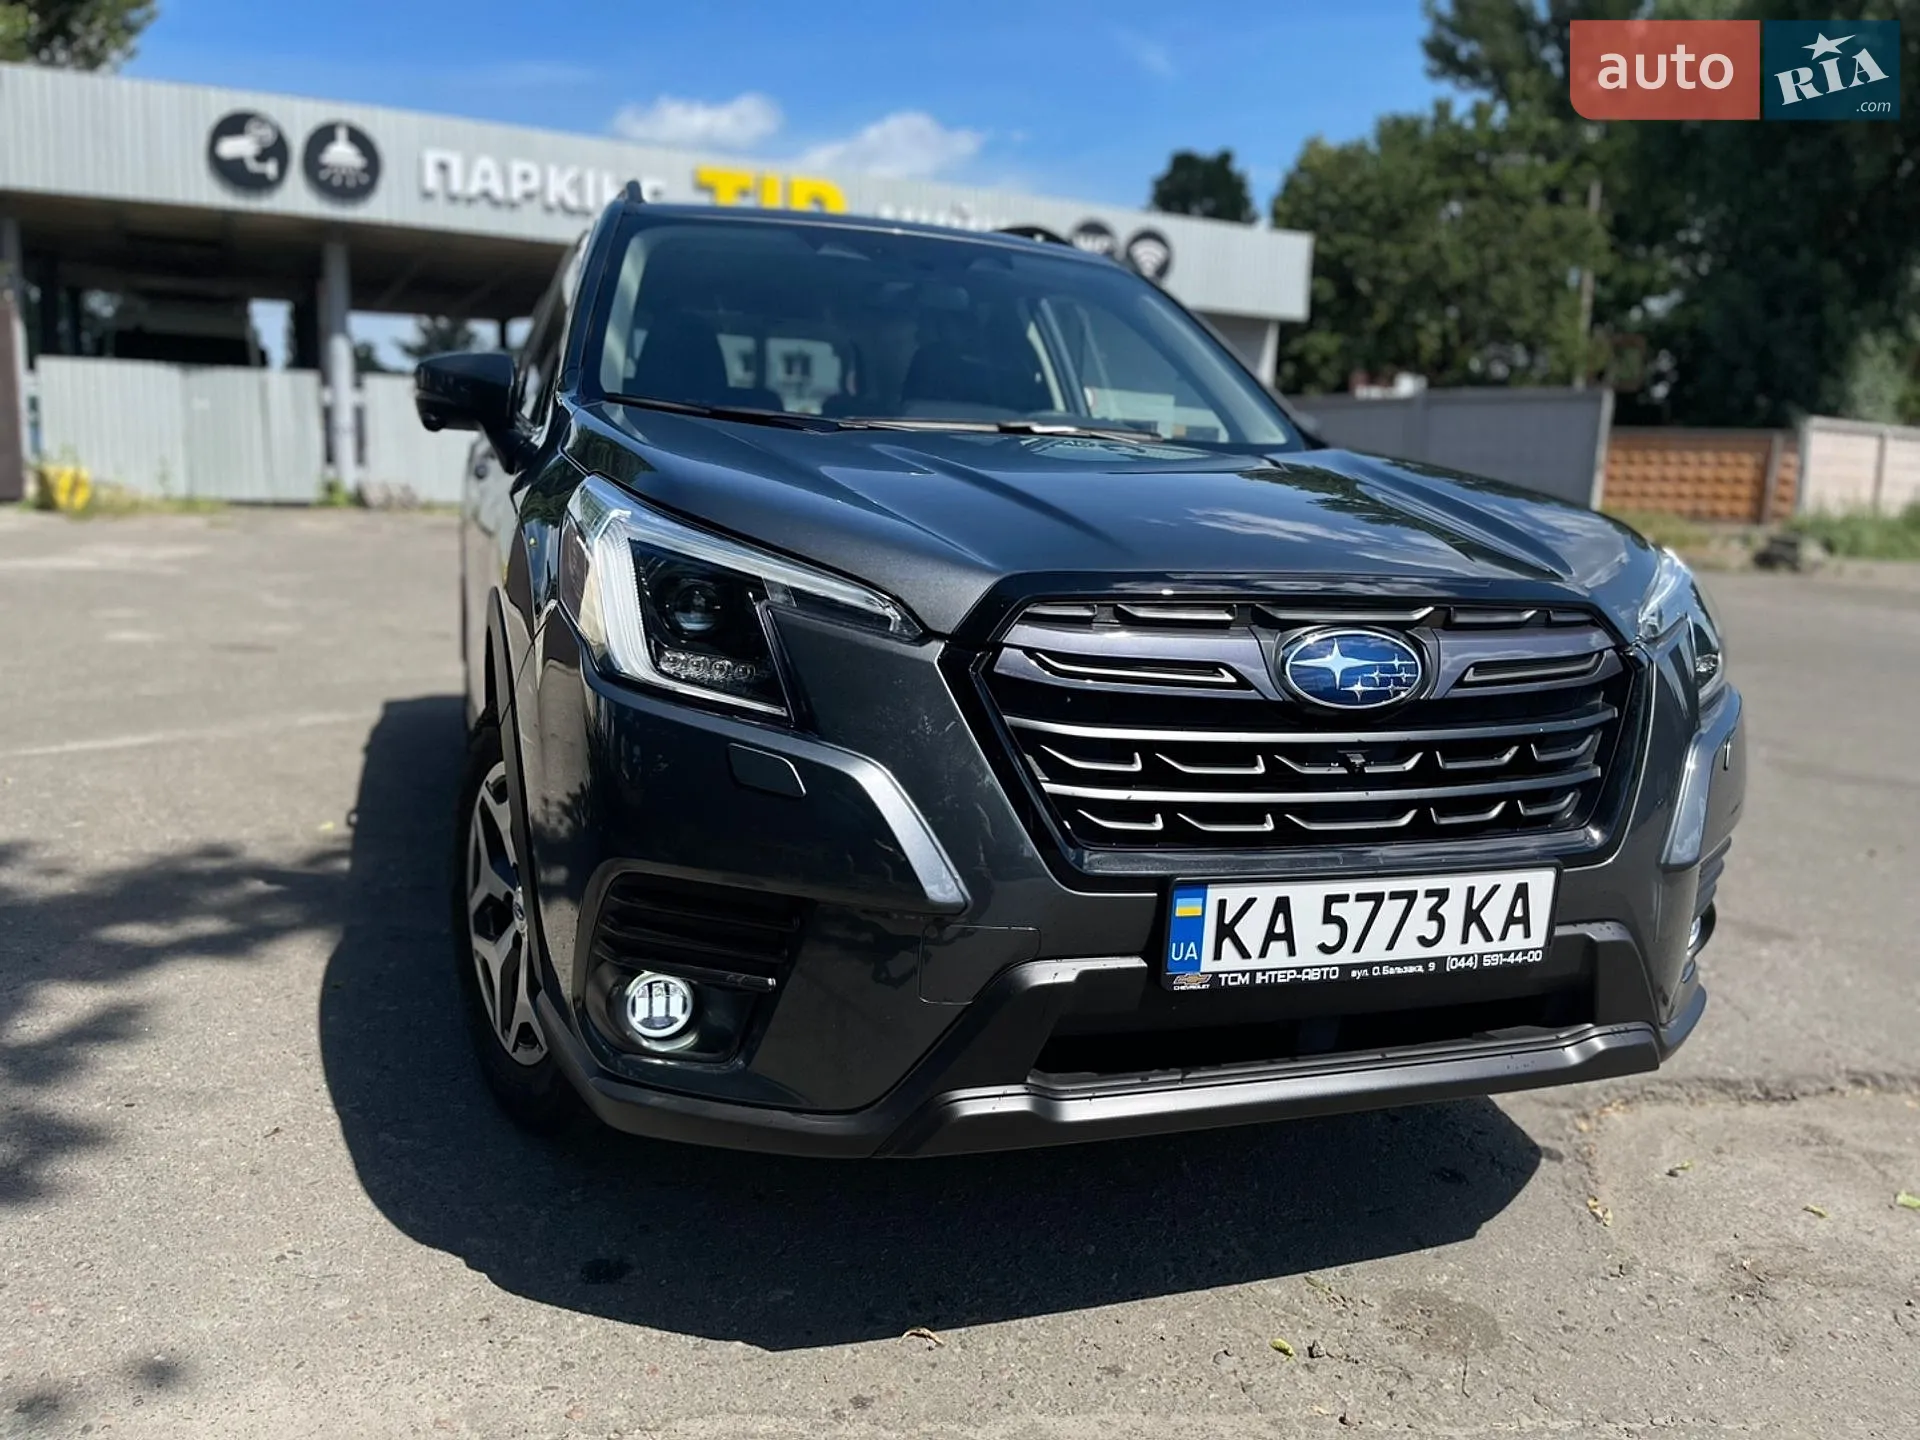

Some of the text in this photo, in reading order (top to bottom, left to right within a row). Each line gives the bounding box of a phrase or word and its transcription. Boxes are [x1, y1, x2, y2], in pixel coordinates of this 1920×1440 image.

[1316, 887, 1451, 955] 5773
[1171, 941, 1198, 961] UA
[1428, 962, 1436, 972] 9
[1446, 953, 1479, 972] (044)
[1482, 949, 1543, 967] 591-44-00
